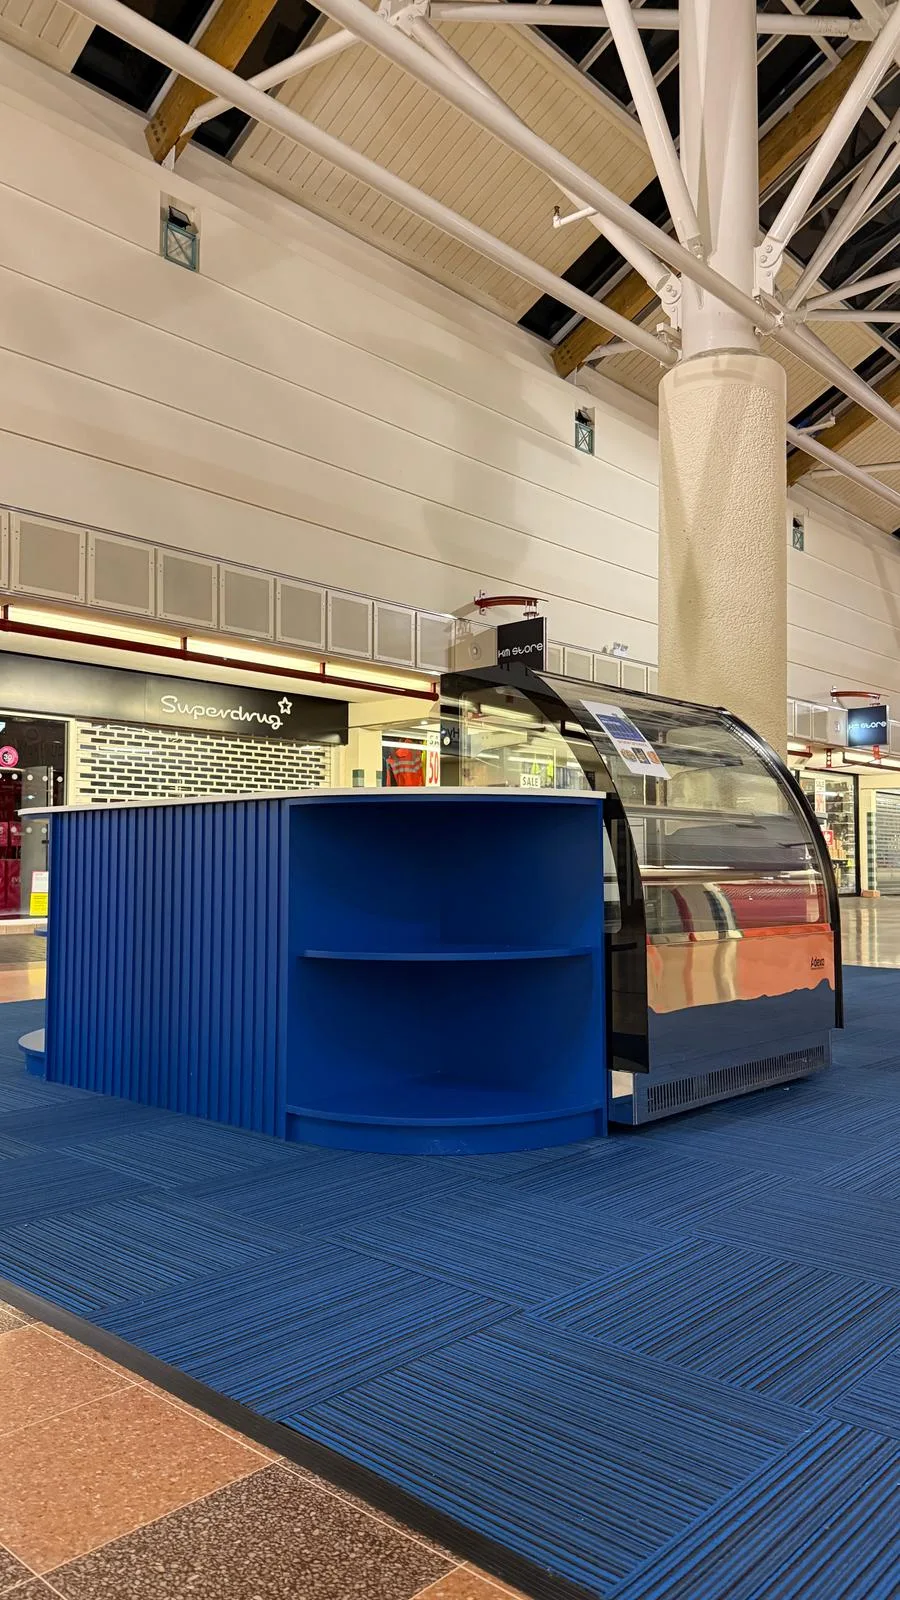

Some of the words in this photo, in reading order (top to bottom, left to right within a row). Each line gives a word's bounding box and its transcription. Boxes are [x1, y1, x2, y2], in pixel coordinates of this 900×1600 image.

[512, 642, 544, 656] store
[160, 695, 284, 730] Superdrug
[522, 776, 539, 787] SALE
